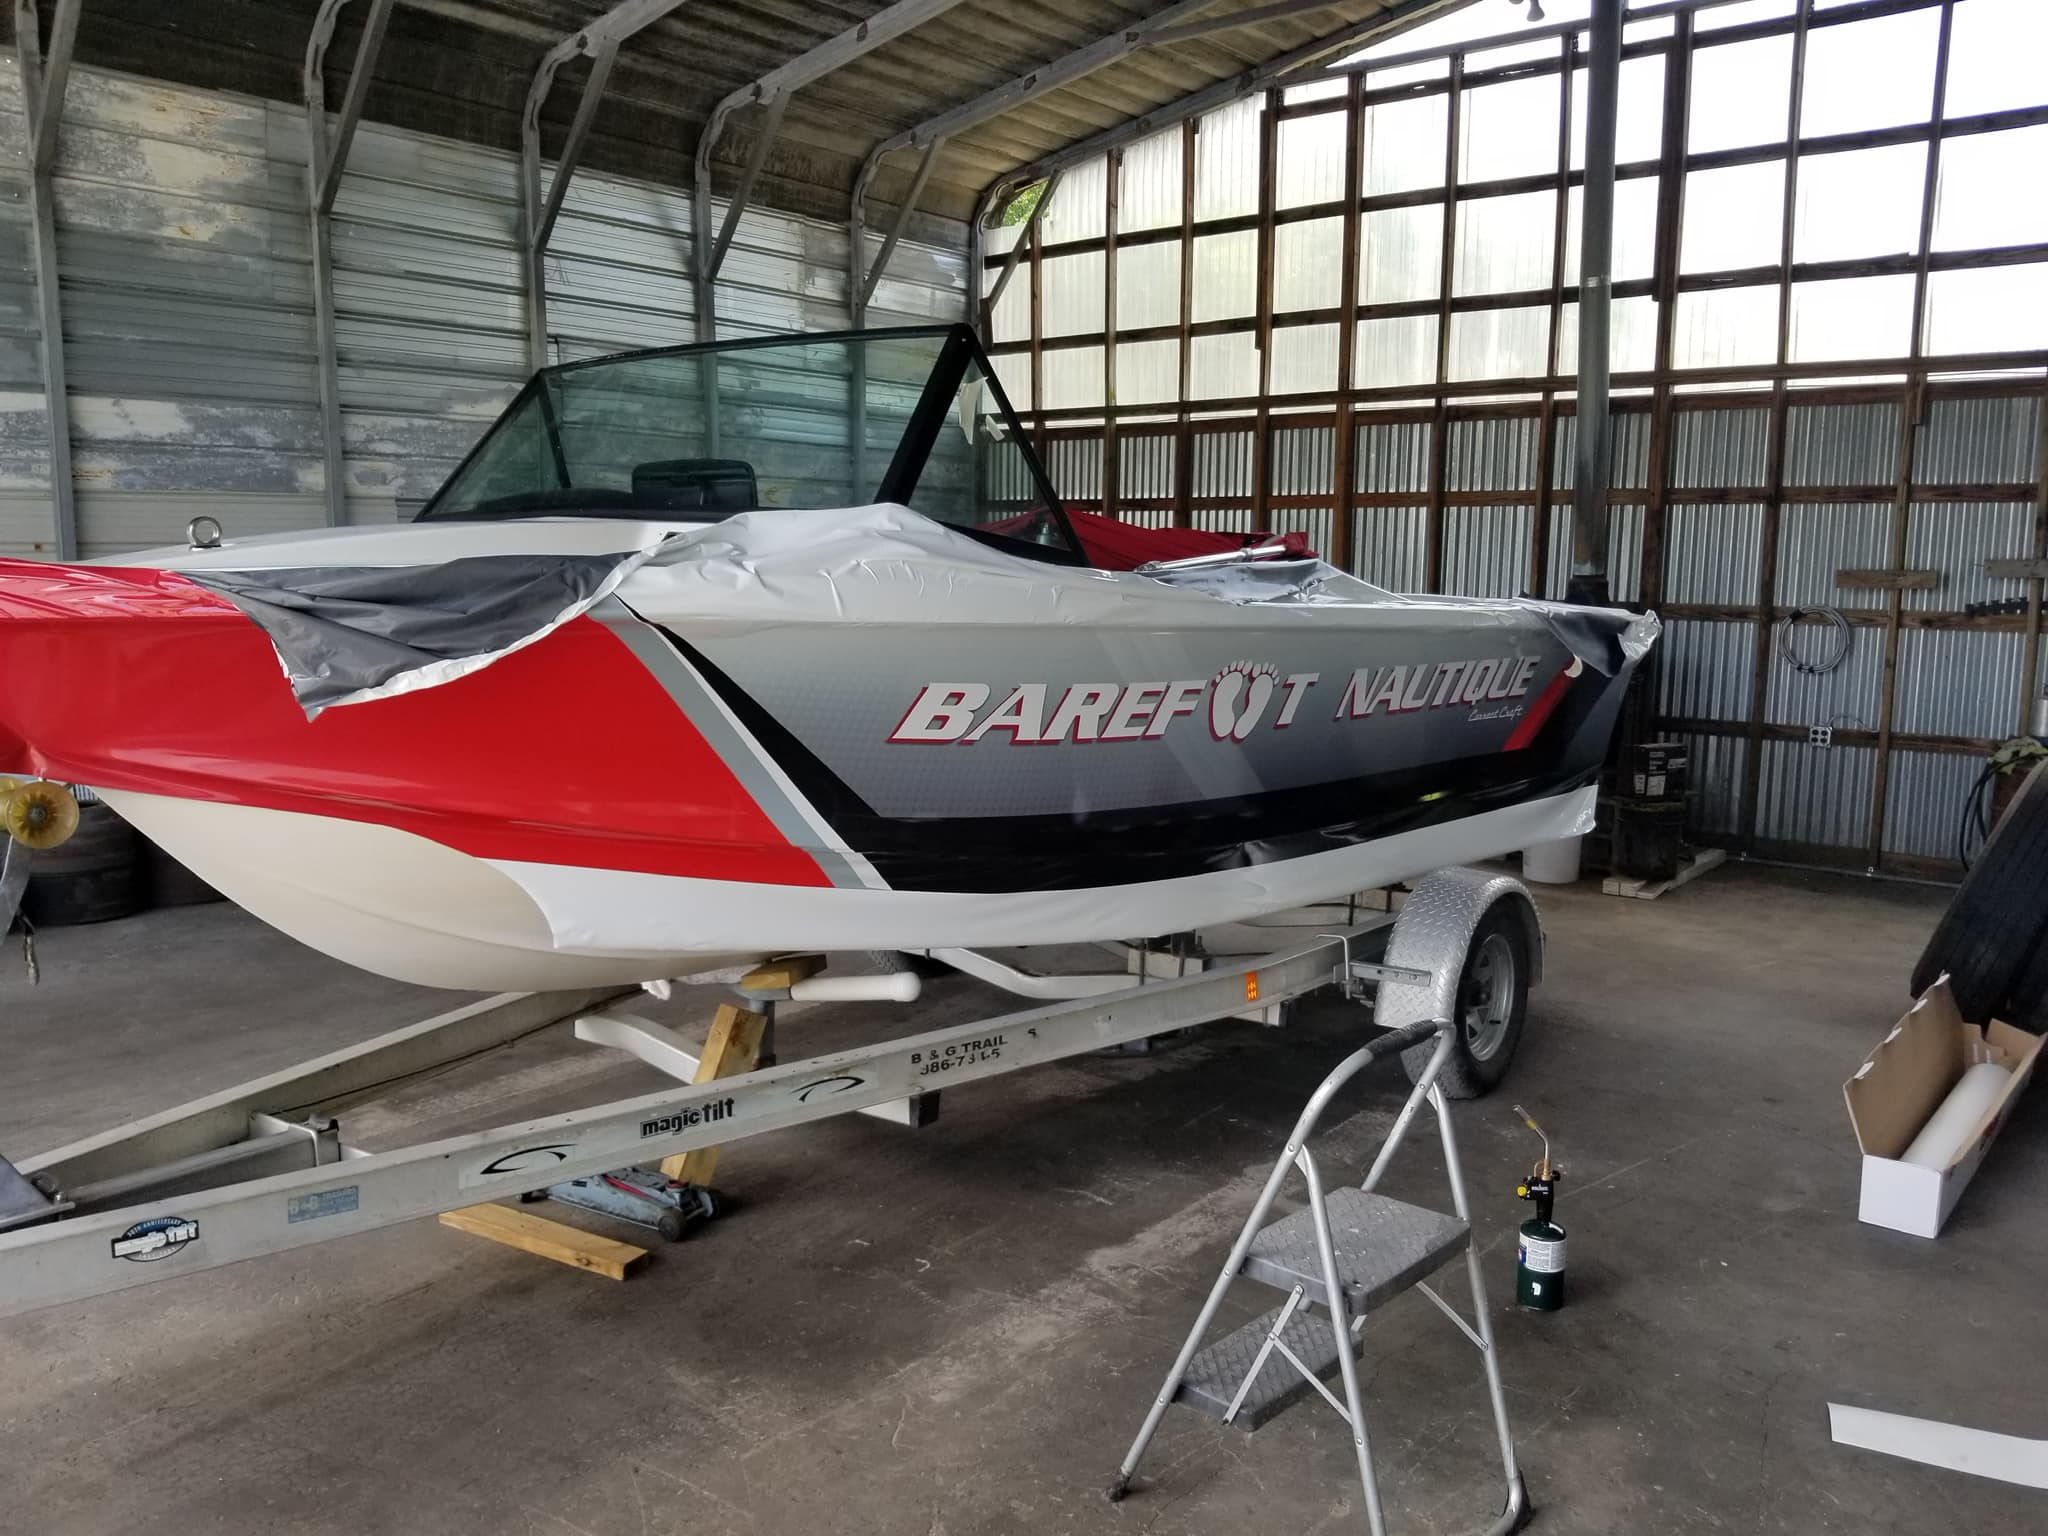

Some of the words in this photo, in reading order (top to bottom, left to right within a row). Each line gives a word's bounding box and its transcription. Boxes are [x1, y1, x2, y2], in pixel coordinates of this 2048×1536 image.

[1333, 655, 1542, 721] NAUTIQUE
[911, 1053, 922, 1064] B
[929, 1049, 940, 1061] &
[945, 1045, 957, 1056] G
